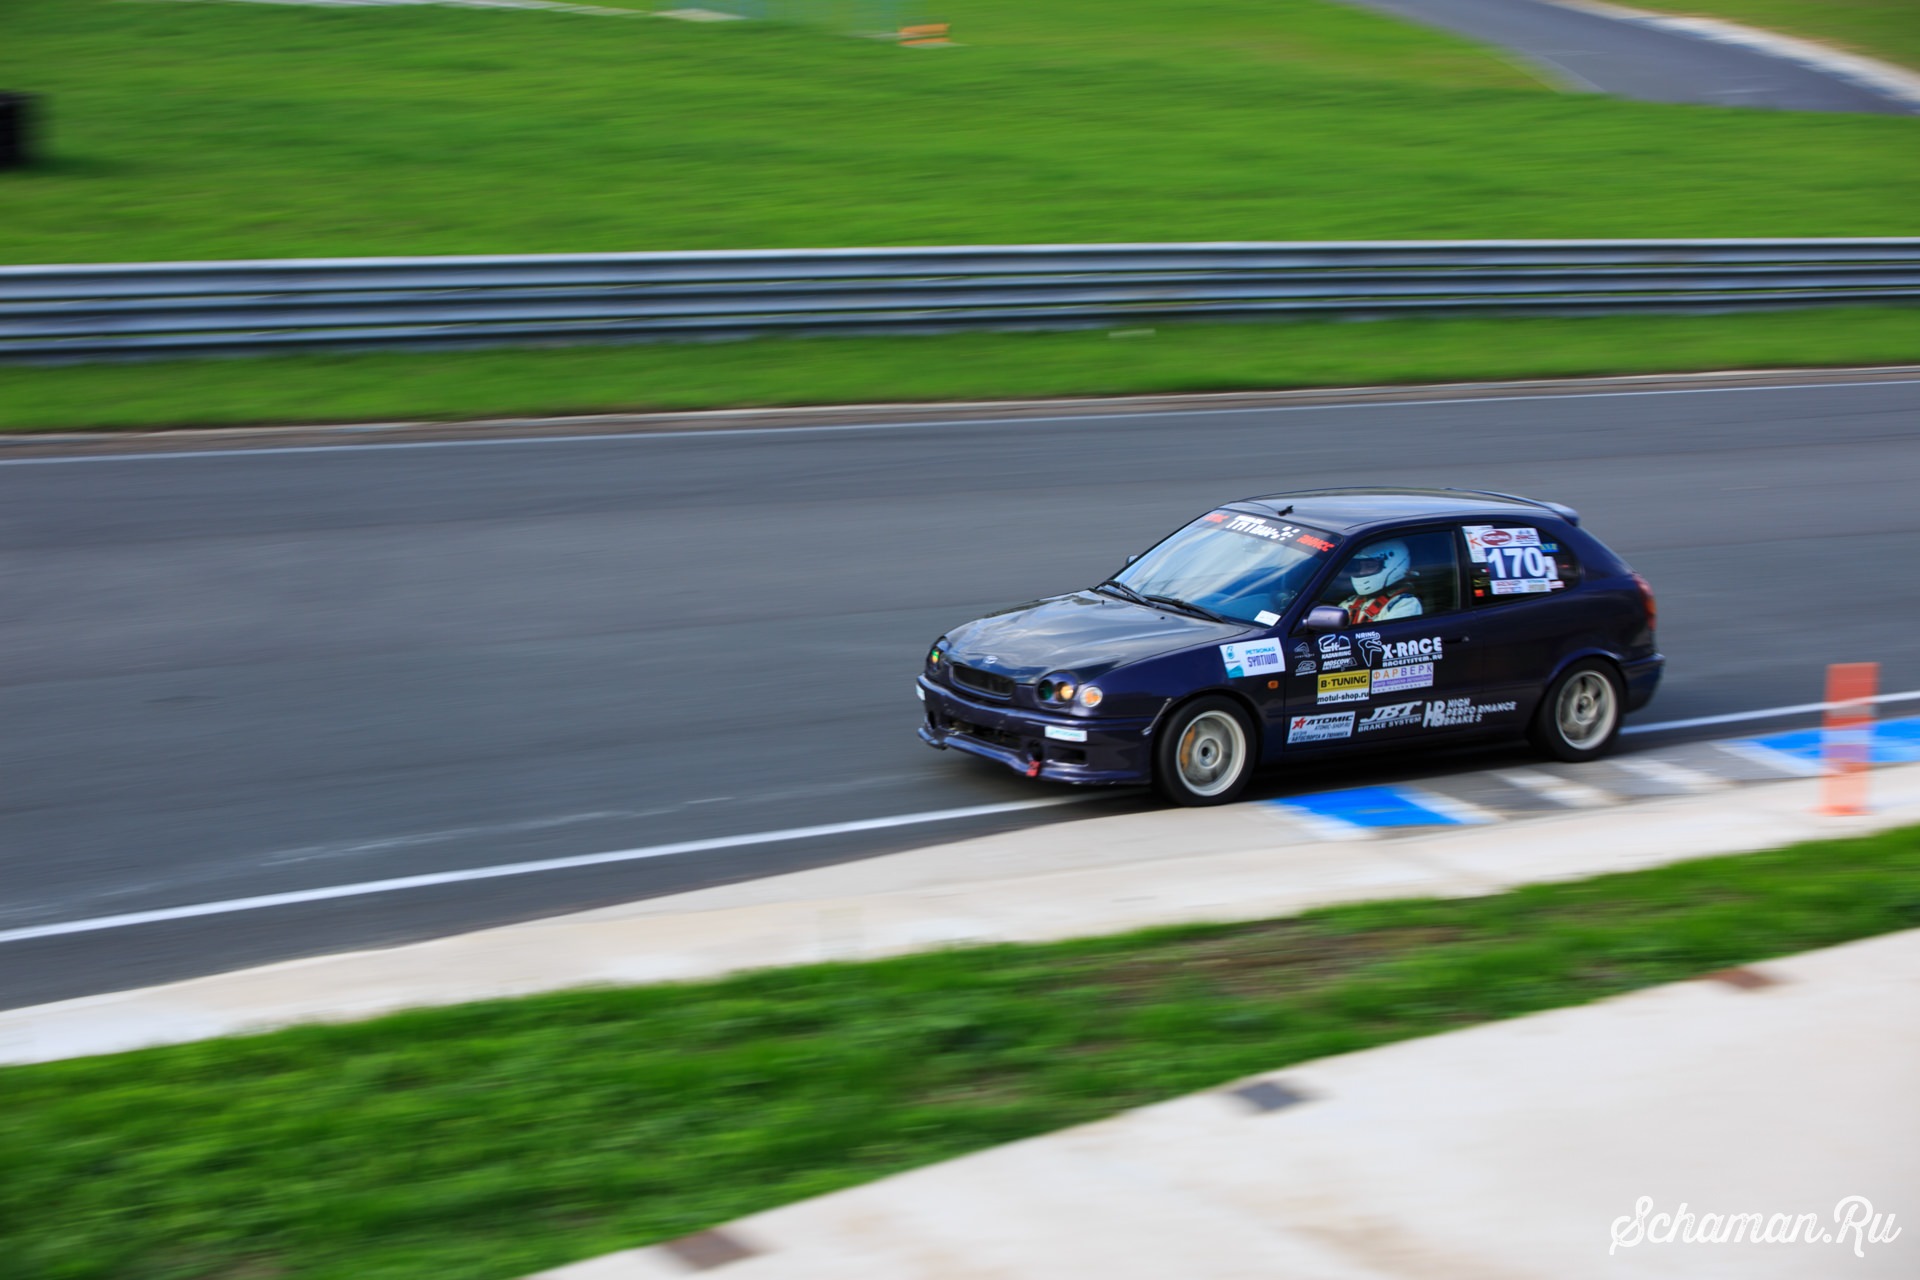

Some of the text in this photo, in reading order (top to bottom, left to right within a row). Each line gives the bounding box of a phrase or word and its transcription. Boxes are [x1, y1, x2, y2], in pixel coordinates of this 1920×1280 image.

[1487, 547, 1546, 578] 170
[1245, 646, 1276, 655] PETRONAS
[1381, 636, 1443, 660] X-RACE
[1247, 653, 1278, 668] SYNTIUM
[1373, 662, 1433, 680] ФАРВЕРК
[1317, 691, 1370, 703] motul-shop.ru
[1307, 714, 1354, 726] ATOMIC
[1359, 700, 1423, 723] JBT
[1358, 716, 1422, 733] BRAKE SYSTEM
